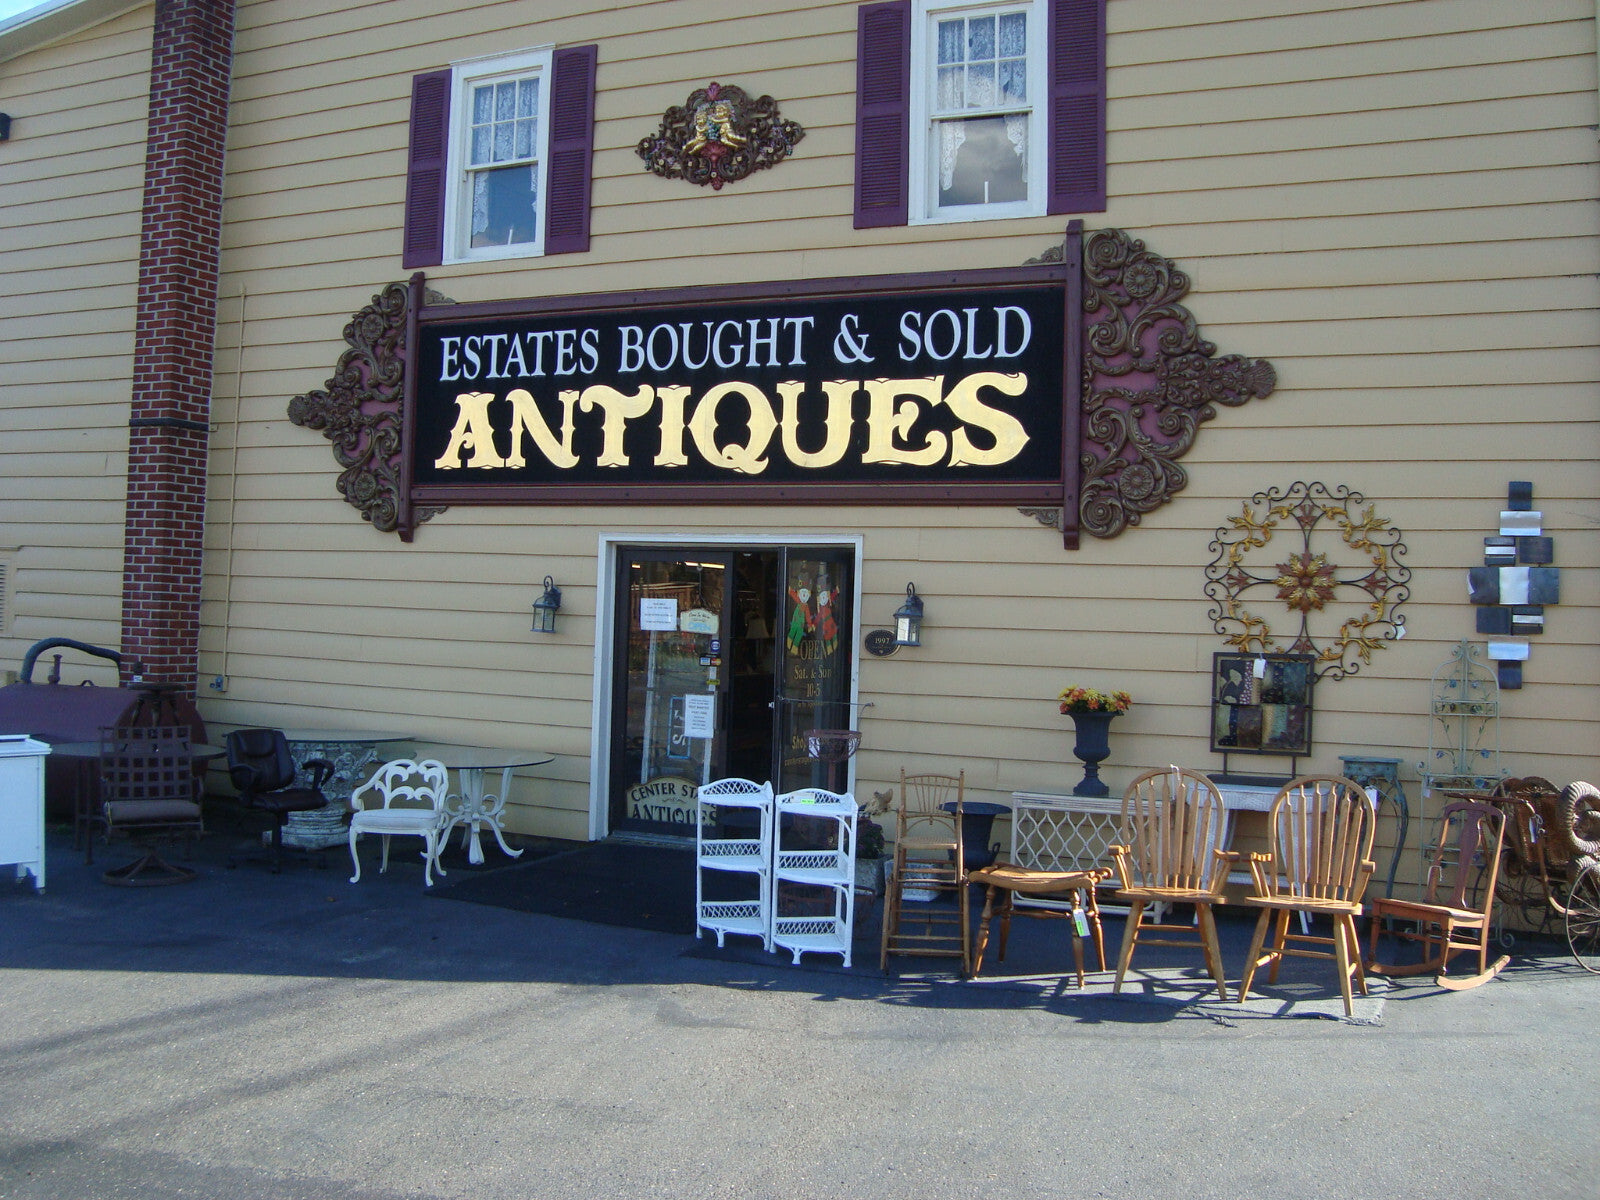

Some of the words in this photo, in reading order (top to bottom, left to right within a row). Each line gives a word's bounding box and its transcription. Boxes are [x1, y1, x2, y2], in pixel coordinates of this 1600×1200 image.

[440, 329, 600, 382] ESTATES
[618, 316, 814, 373] BOUGHT
[833, 314, 875, 366] &
[898, 305, 1033, 362] SOLD
[434, 371, 1031, 475] ANTIQUES
[800, 640, 827, 661] OPEN
[794, 664, 808, 680] Sat.
[806, 683, 821, 698] 10-5
[631, 782, 676, 802] CENTER
